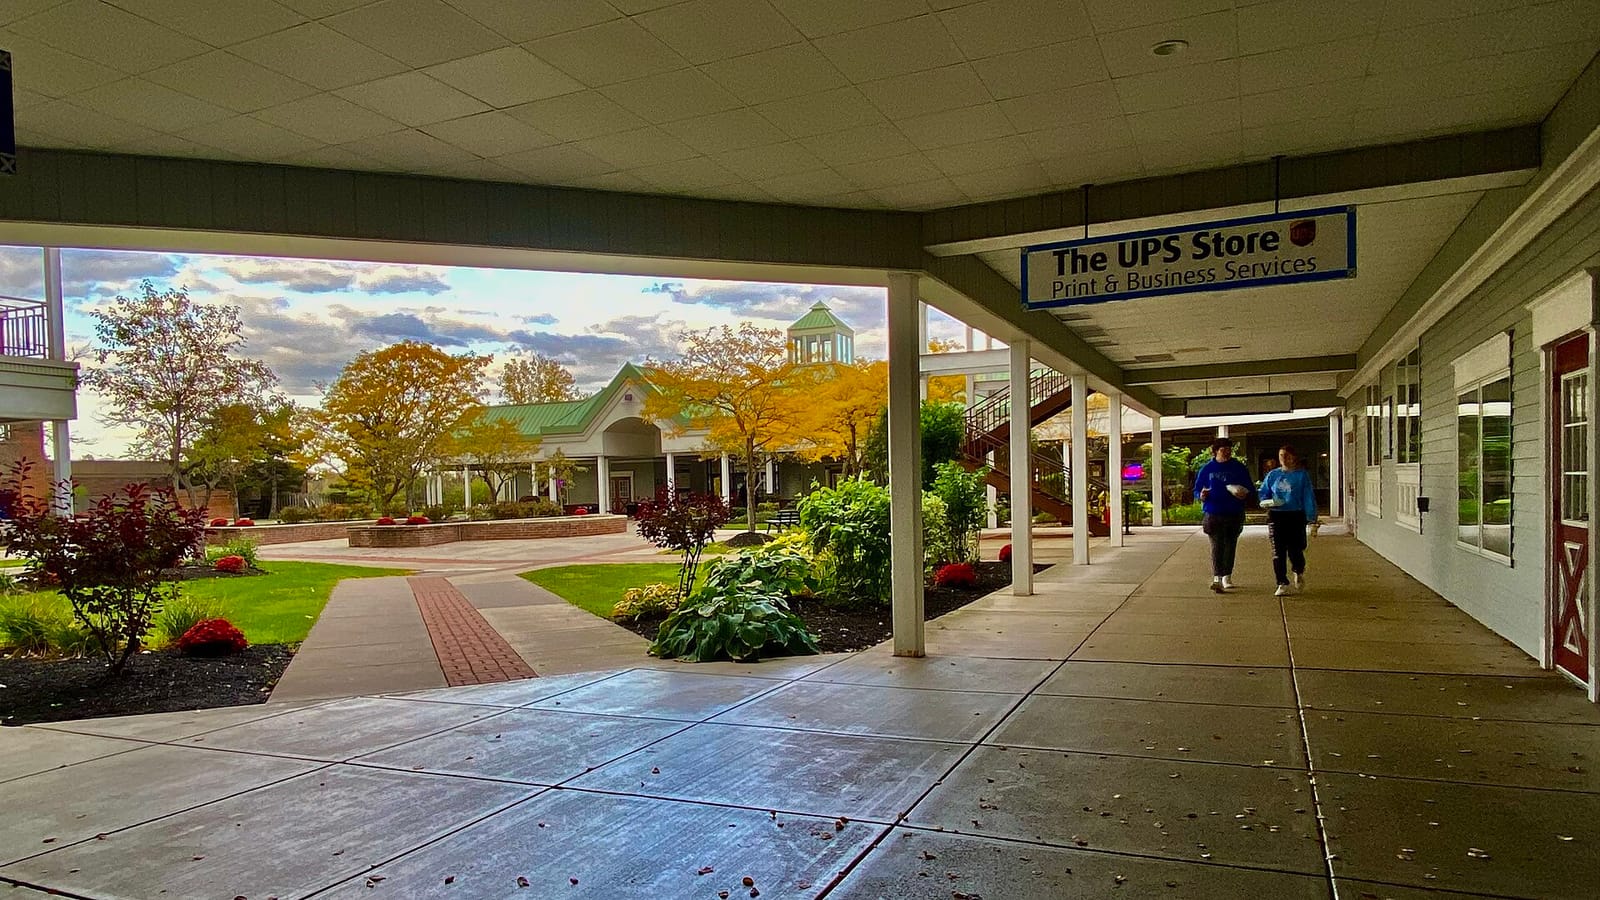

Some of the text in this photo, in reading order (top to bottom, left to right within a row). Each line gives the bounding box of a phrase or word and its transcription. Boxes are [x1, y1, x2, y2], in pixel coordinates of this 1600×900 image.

[1052, 230, 1280, 276] The UPS Store
[1052, 256, 1316, 299] Print & Business Services
